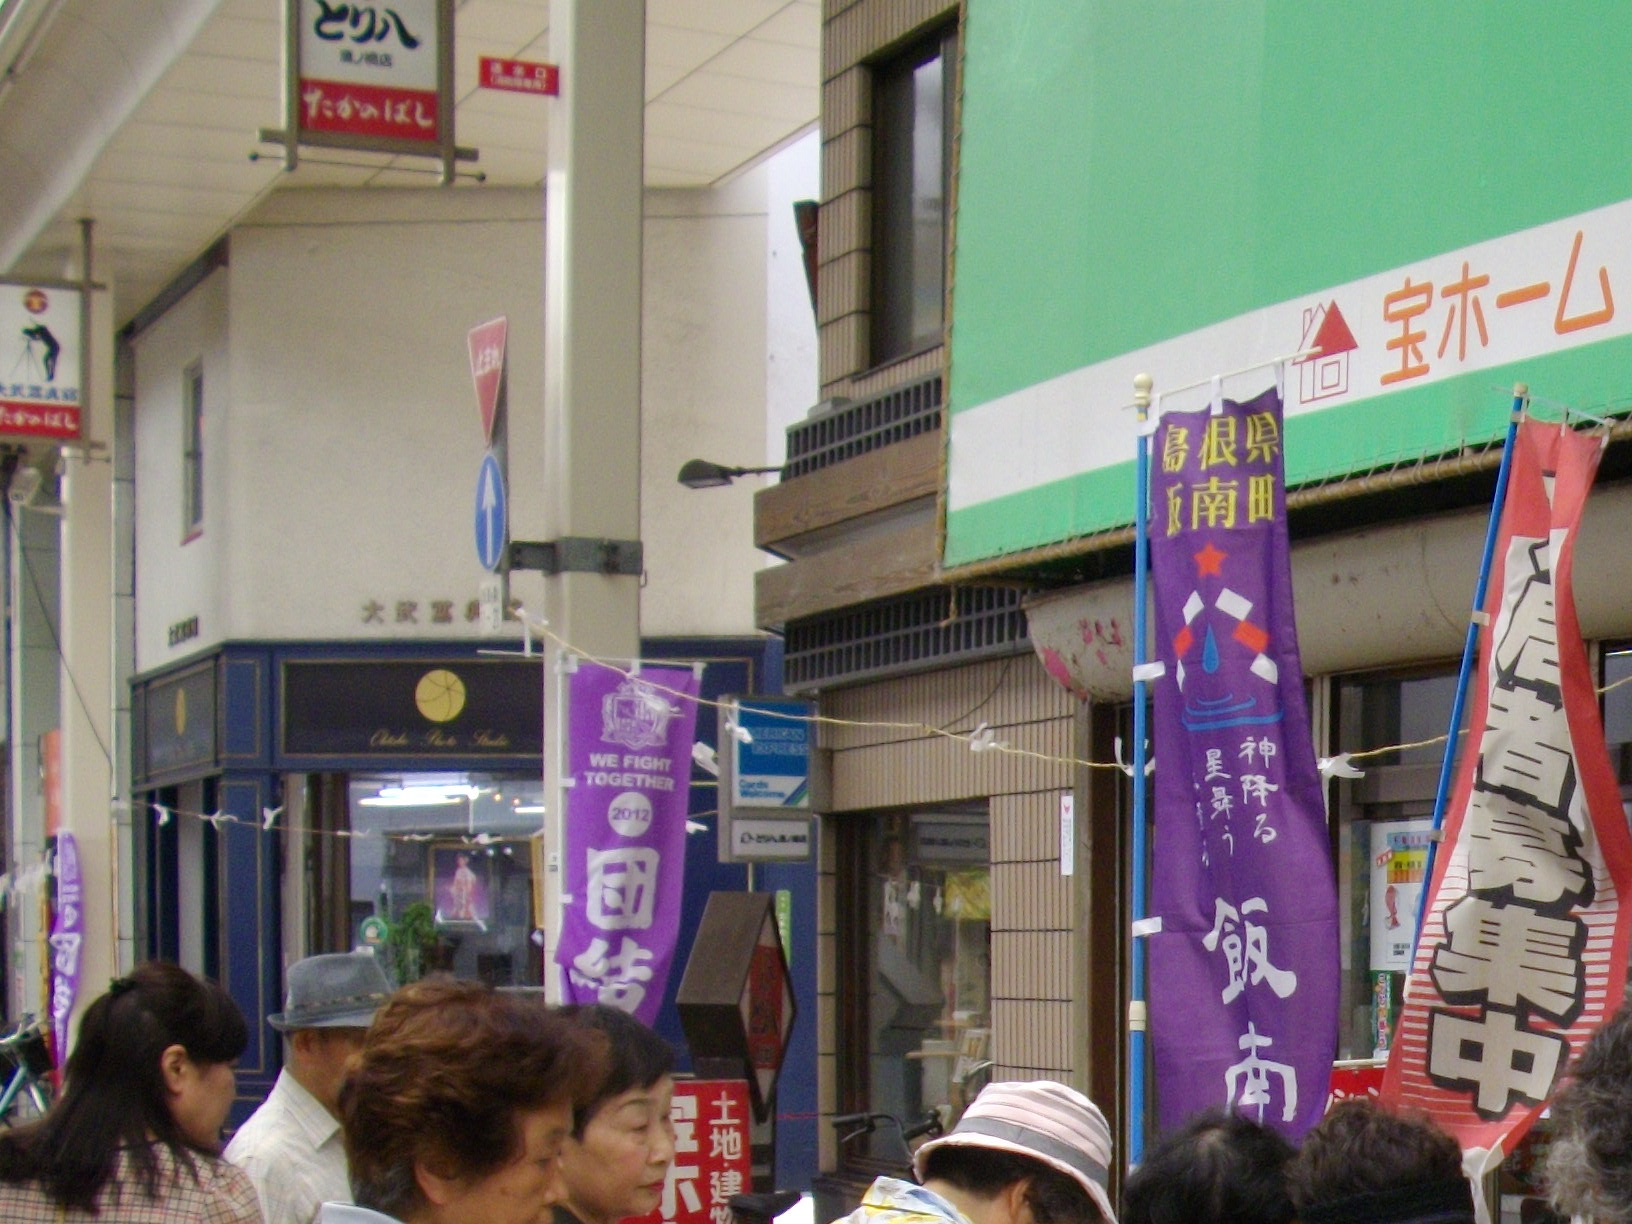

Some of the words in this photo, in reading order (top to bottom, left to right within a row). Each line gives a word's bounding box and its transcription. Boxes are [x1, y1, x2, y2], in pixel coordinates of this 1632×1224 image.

[1380, 230, 1614, 386] 宝ホーム
[584, 771, 675, 792] TOGETHER
[590, 753, 619, 768] WE
[623, 755, 672, 772] FIGHT
[1238, 736, 1279, 844] 神降る
[612, 807, 650, 821] 2012
[1431, 530, 1590, 1112] 居者募集中
